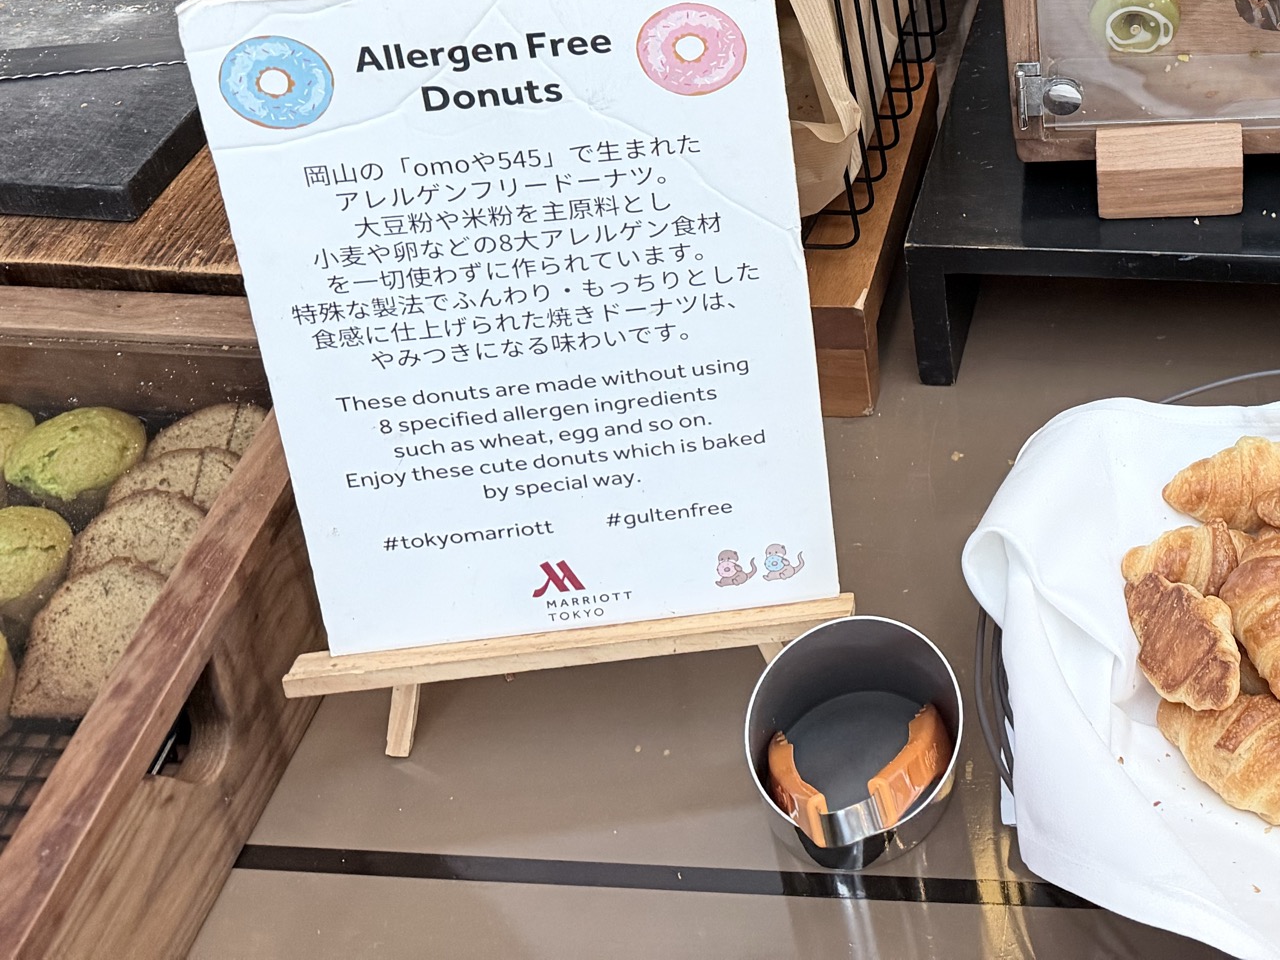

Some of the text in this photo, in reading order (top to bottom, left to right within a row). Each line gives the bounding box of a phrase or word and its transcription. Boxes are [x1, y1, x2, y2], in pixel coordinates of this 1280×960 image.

[356, 32, 612, 73] Allergen Free
[421, 80, 563, 112] Donuts
[336, 167, 667, 212] アレルゲンフリードーナツ。
[354, 192, 671, 239] 大豆粉や米粉を主原料とし
[314, 211, 722, 270] 小麦や卵などの8大アレルゲン食材
[327, 243, 704, 294] を一切使わずに作られています。
[291, 262, 760, 326] 特殊な製法でふんわり・もっちりとした
[312, 292, 736, 350] 食感に仕上げられた焼きドーナツは、
[371, 323, 689, 370] やみつきになる味わいです。
[335, 359, 750, 413] These donuts are made without using
[379, 387, 718, 435] 8 specified allergen ingredients
[346, 429, 767, 489] Enjoy these cute donuts which is baked
[394, 414, 712, 458] such as wheat, egg and so on.
[483, 471, 642, 501] by special way.
[383, 501, 734, 552] #tokyomarriott #gultenfree
[546, 590, 633, 609] MARRIOTT
[548, 607, 605, 622] TOKYO
